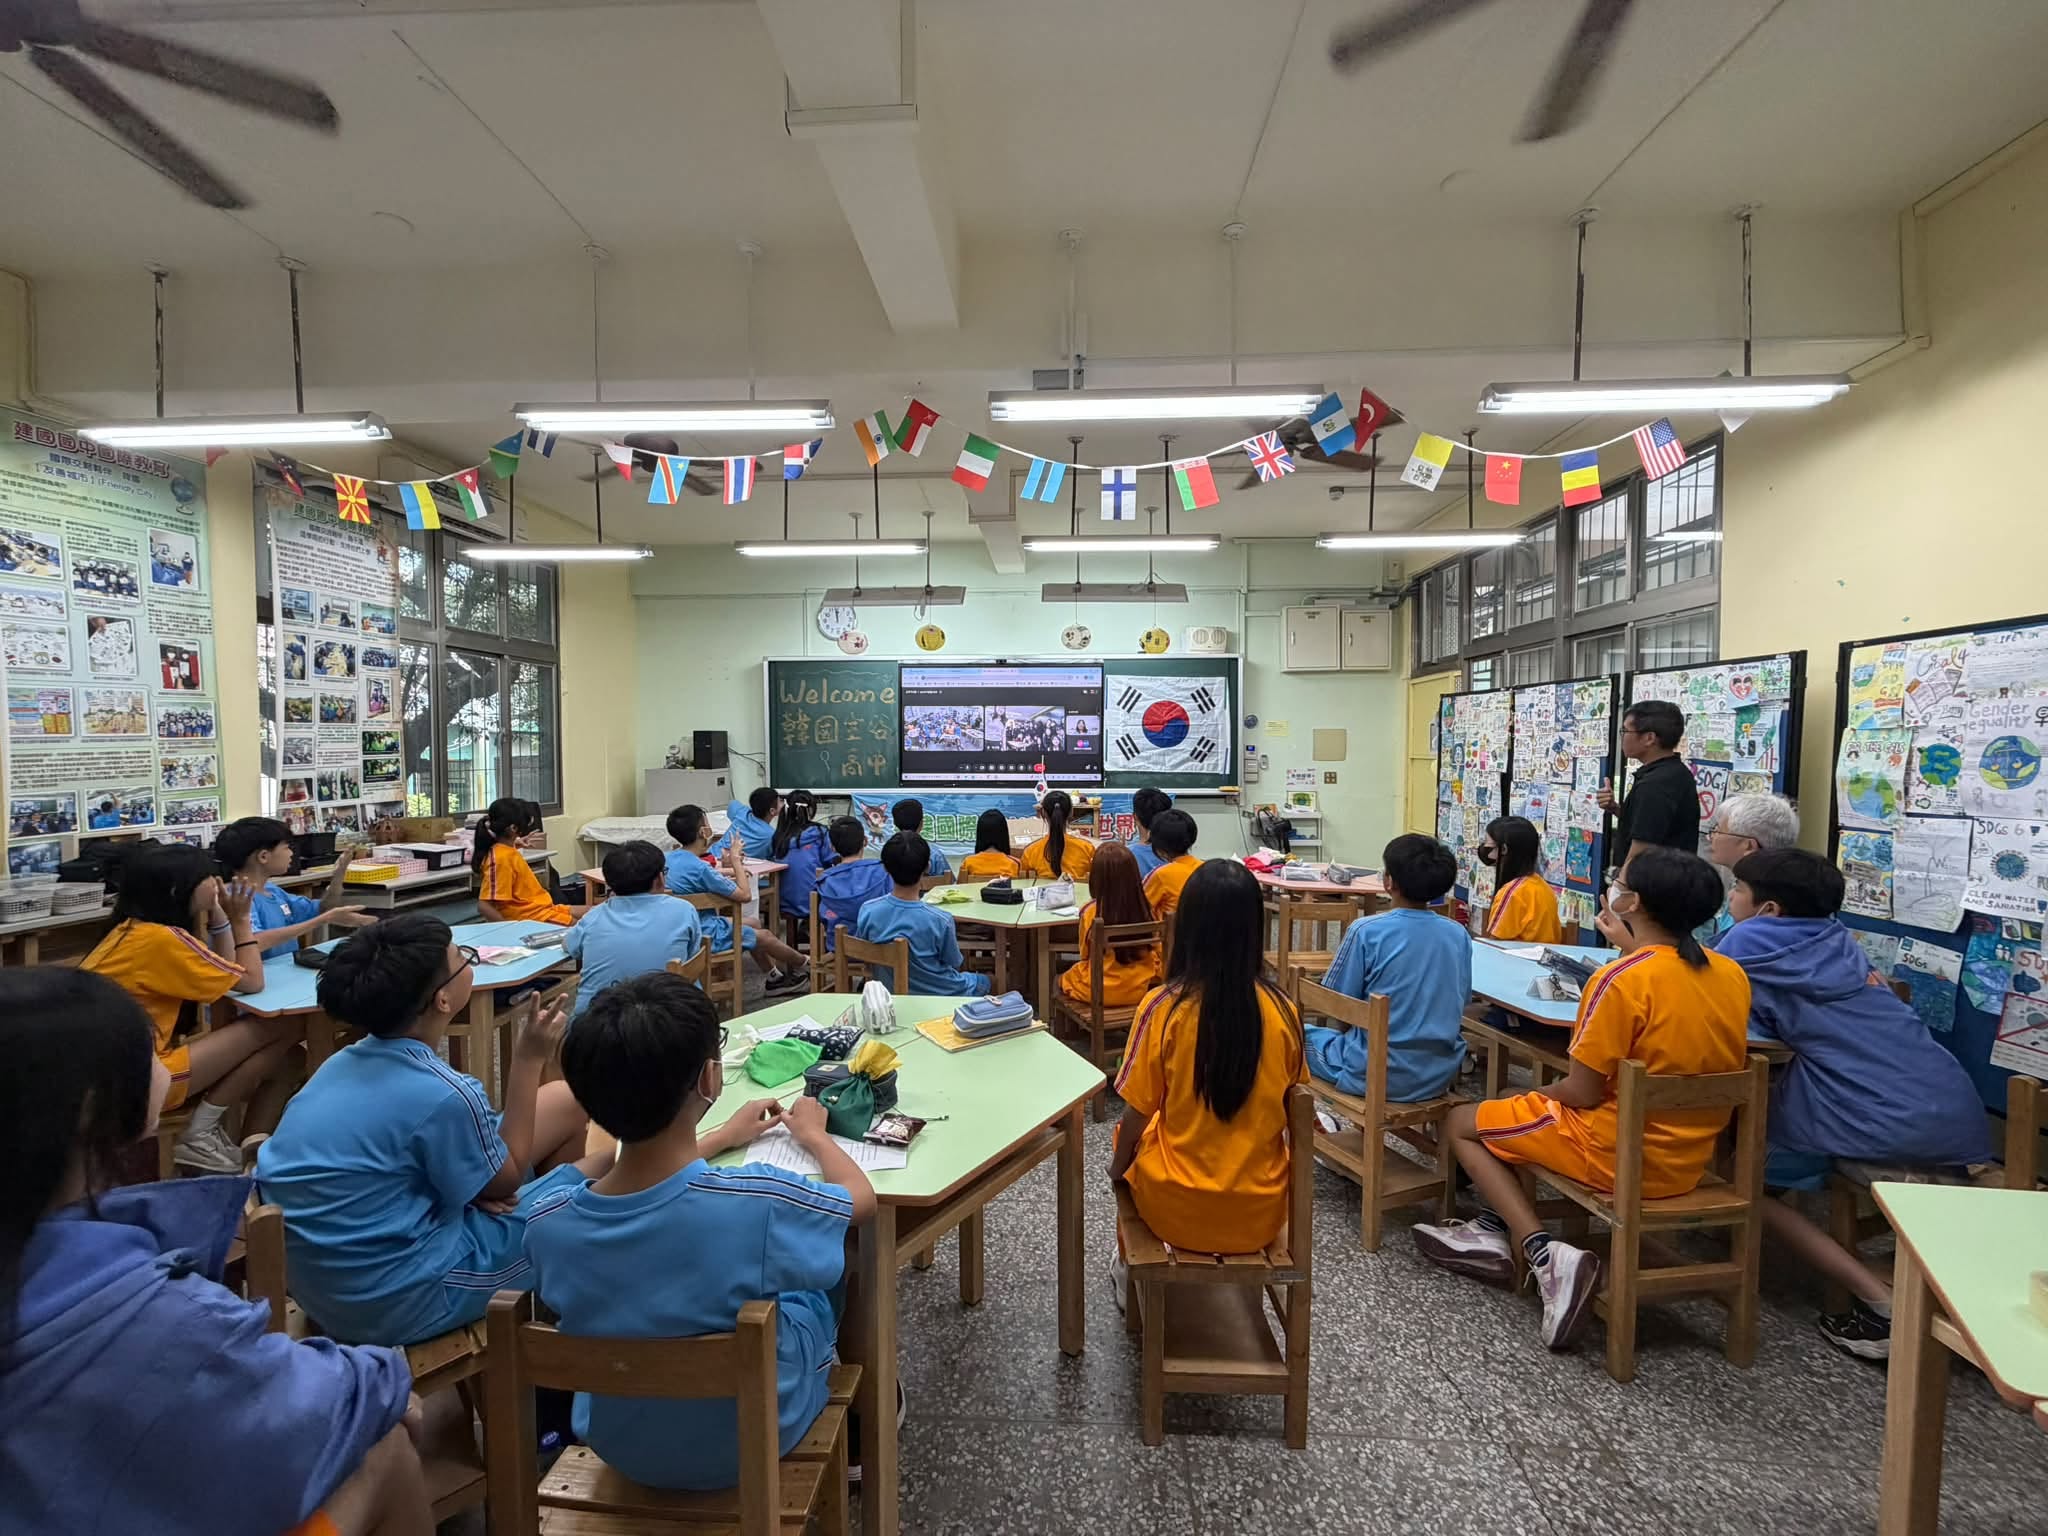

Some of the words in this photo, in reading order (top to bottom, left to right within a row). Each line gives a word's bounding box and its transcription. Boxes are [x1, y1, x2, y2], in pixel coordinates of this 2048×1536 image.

[14, 421, 170, 479] 建國國中國際教育
[779, 678, 895, 704] Welcome
[1969, 700, 2030, 718] Gender
[1968, 715, 2032, 734] equality
[841, 748, 887, 777] 高中
[1696, 768, 1725, 791] SDGs
[1976, 820, 2009, 835] SDGs
[2014, 823, 2025, 836] 6
[1968, 889, 2001, 900] CLEAN
[1902, 952, 1928, 968] SDGs
